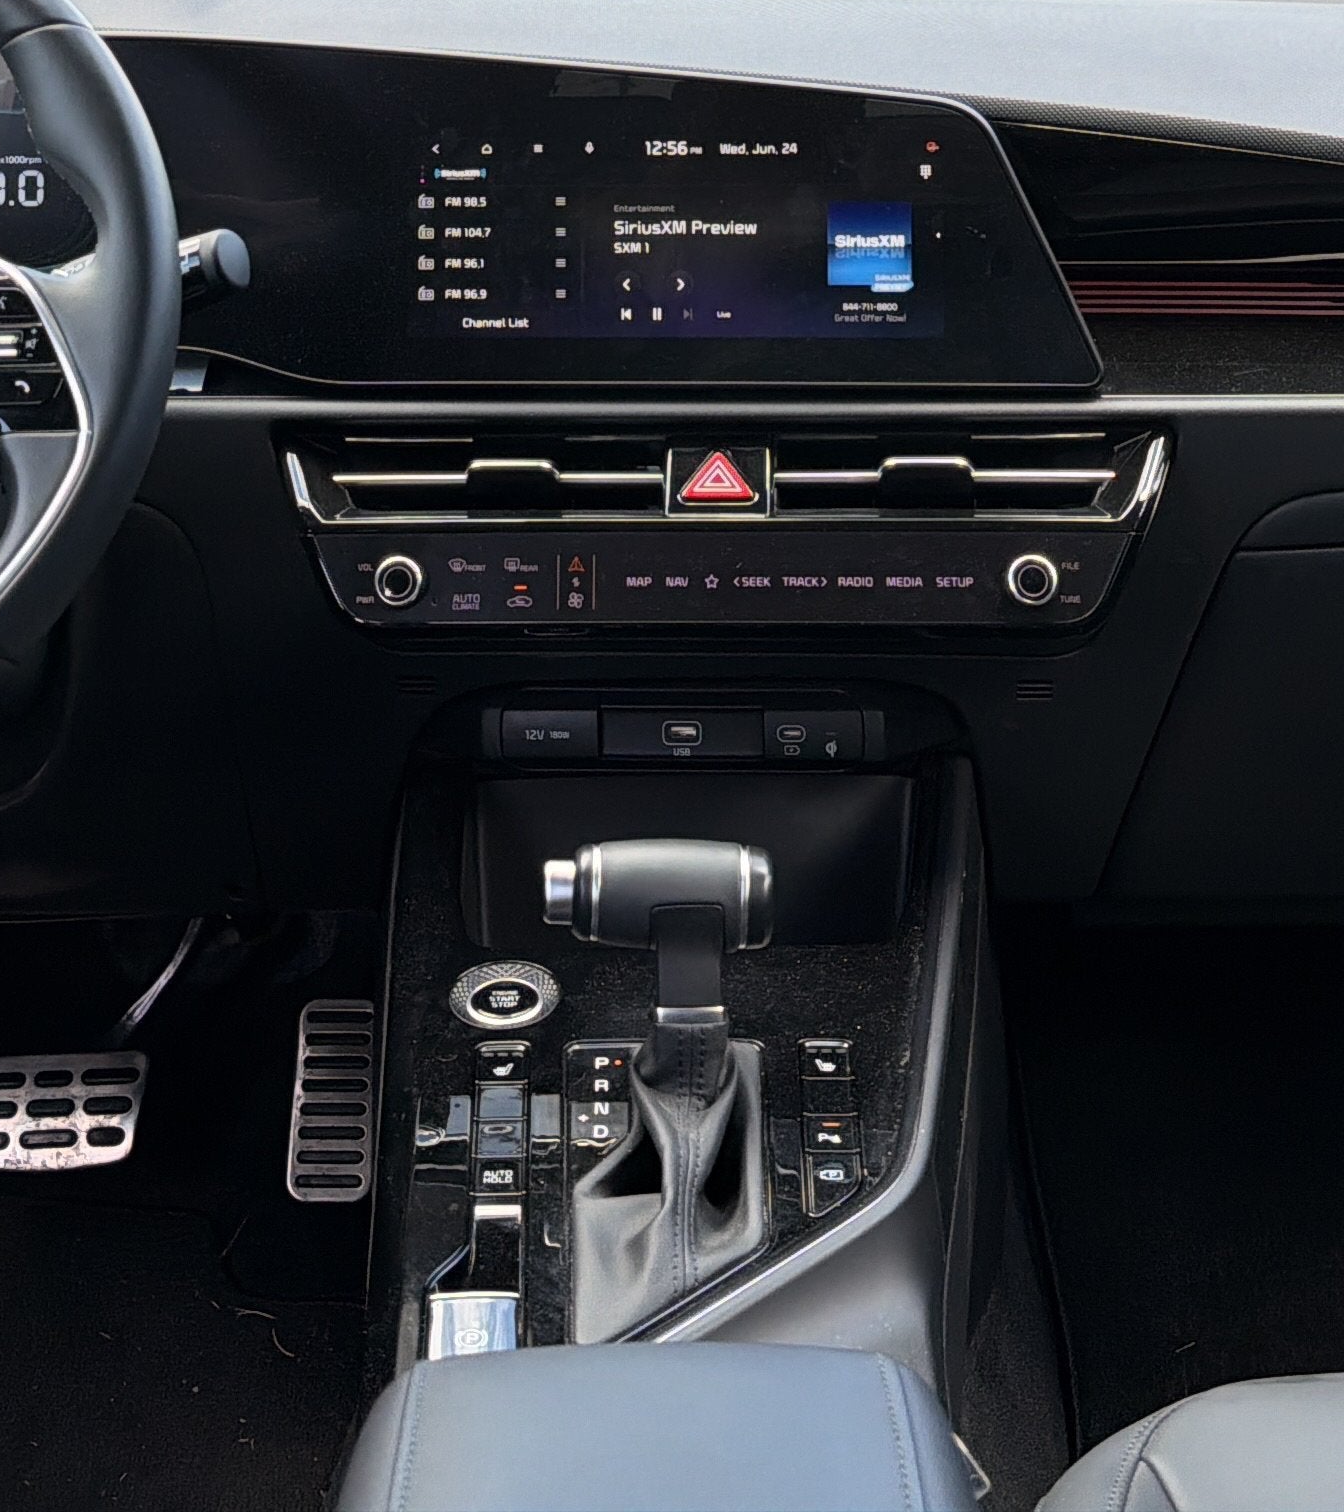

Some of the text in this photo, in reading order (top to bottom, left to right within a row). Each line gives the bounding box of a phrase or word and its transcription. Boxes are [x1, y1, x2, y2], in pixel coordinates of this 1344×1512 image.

[644, 141, 688, 156] 12:56
[782, 143, 798, 155] 24
[445, 197, 462, 207] FM
[613, 204, 675, 213] Entertainment
[445, 228, 462, 238] FM
[614, 220, 758, 235] SiriusXM Preview
[834, 234, 905, 248] SiriusXM
[614, 242, 642, 254] SXM
[445, 259, 462, 269] FM
[445, 290, 487, 301] FM 96.9
[462, 317, 530, 330] Channel List
[834, 314, 859, 322] Great
[861, 314, 883, 322] Offer
[358, 564, 374, 572] VOL
[1061, 562, 1080, 570] FILE
[626, 576, 689, 588] MAP NAV
[837, 576, 874, 588] RADIO
[886, 576, 923, 588] MEDIA
[935, 576, 974, 588] SETUP
[356, 596, 375, 604] PWR
[452, 594, 481, 603] AUTO
[1059, 595, 1081, 603] TUNE
[525, 730, 545, 740] 12V
[672, 748, 691, 756] USB
[594, 1056, 609, 1070] P
[594, 1079, 609, 1092] R
[594, 1102, 609, 1115] N
[594, 1125, 609, 1138] D
[483, 1176, 514, 1184] HOLD
